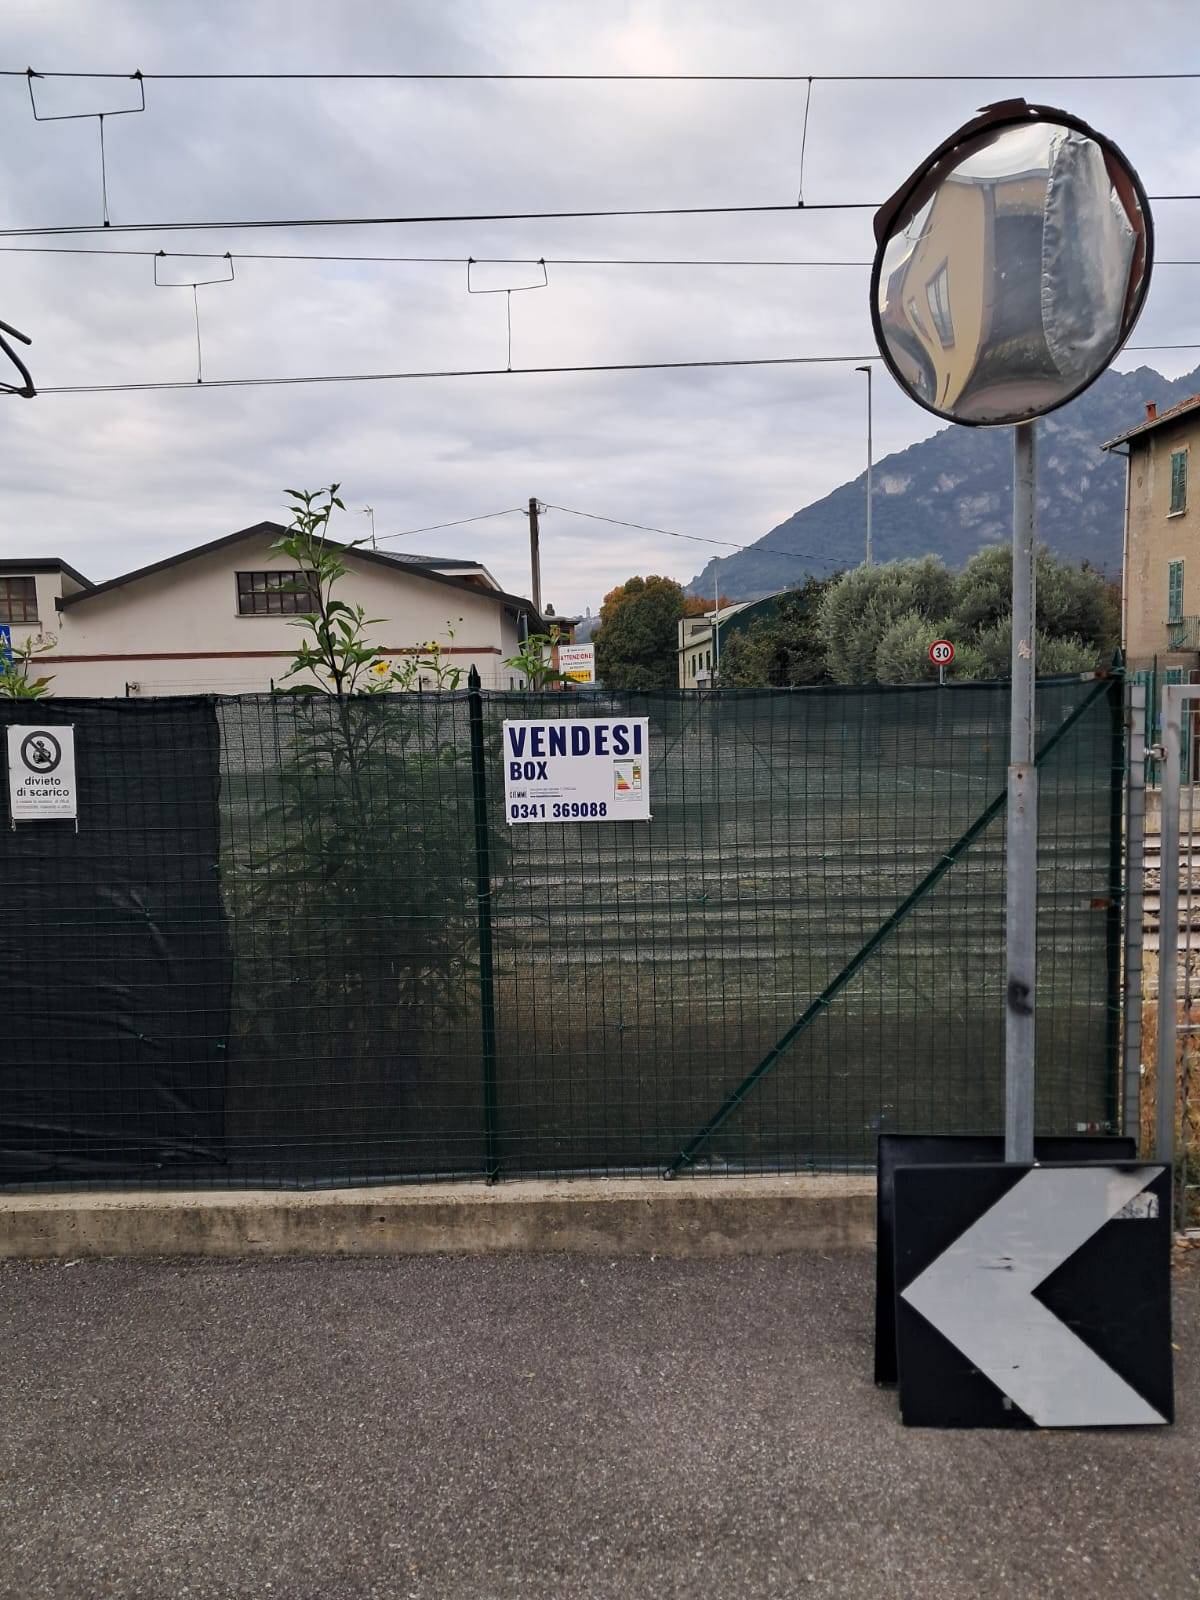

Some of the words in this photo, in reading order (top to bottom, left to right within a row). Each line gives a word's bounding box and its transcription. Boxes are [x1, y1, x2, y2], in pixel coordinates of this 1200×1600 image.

[936, 647, 949, 658] 30
[508, 724, 642, 758] VENDESI
[510, 761, 548, 781] BOX
[25, 776, 61, 785] divieto
[17, 788, 26, 796] di
[30, 788, 69, 796] scarico
[511, 804, 546, 819] 0341
[552, 802, 607, 817] 369088
